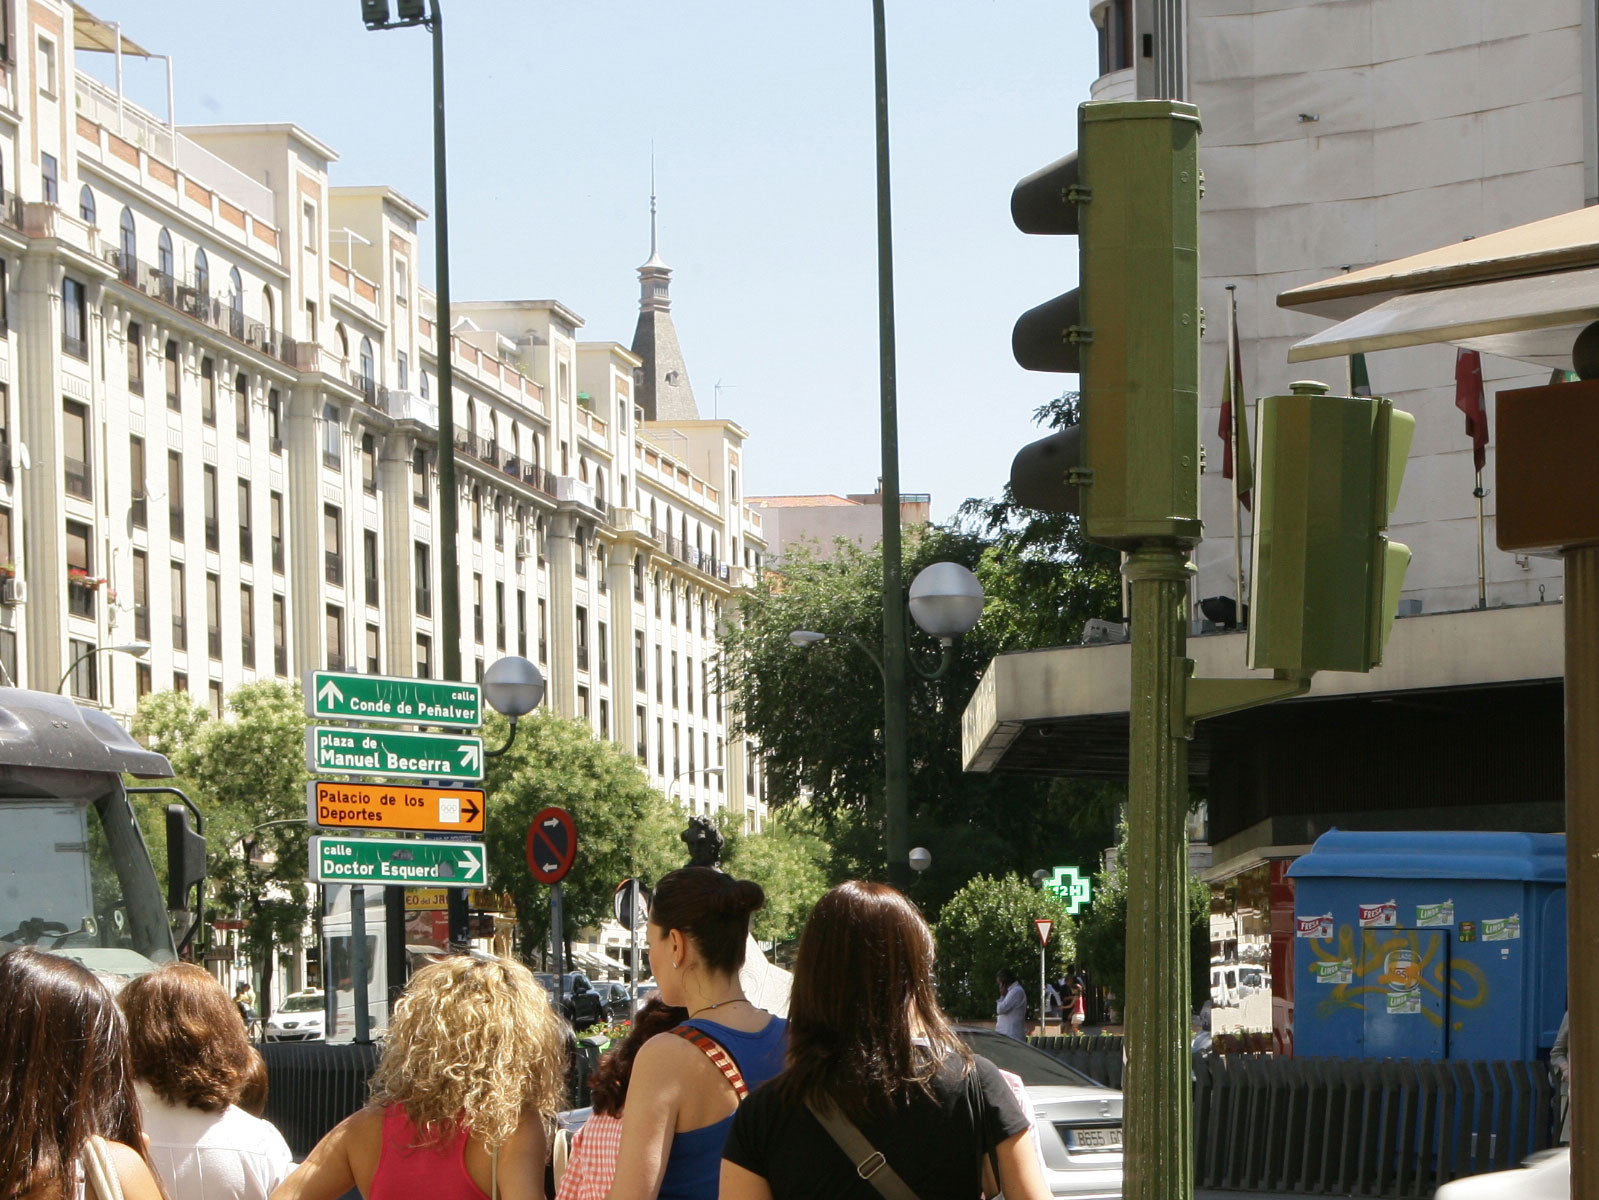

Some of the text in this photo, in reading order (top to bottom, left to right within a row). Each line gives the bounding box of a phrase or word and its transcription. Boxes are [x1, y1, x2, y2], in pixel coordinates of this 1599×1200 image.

[451, 690, 475, 701] calle
[350, 698, 475, 720] Conde de Peñalver
[320, 734, 377, 749] plaza de
[320, 749, 451, 772] Manuel Becerra
[320, 790, 424, 807] Palacio de los
[320, 806, 382, 822] Deportes
[324, 844, 352, 855] calle
[324, 860, 440, 879] Doctor Esquerd
